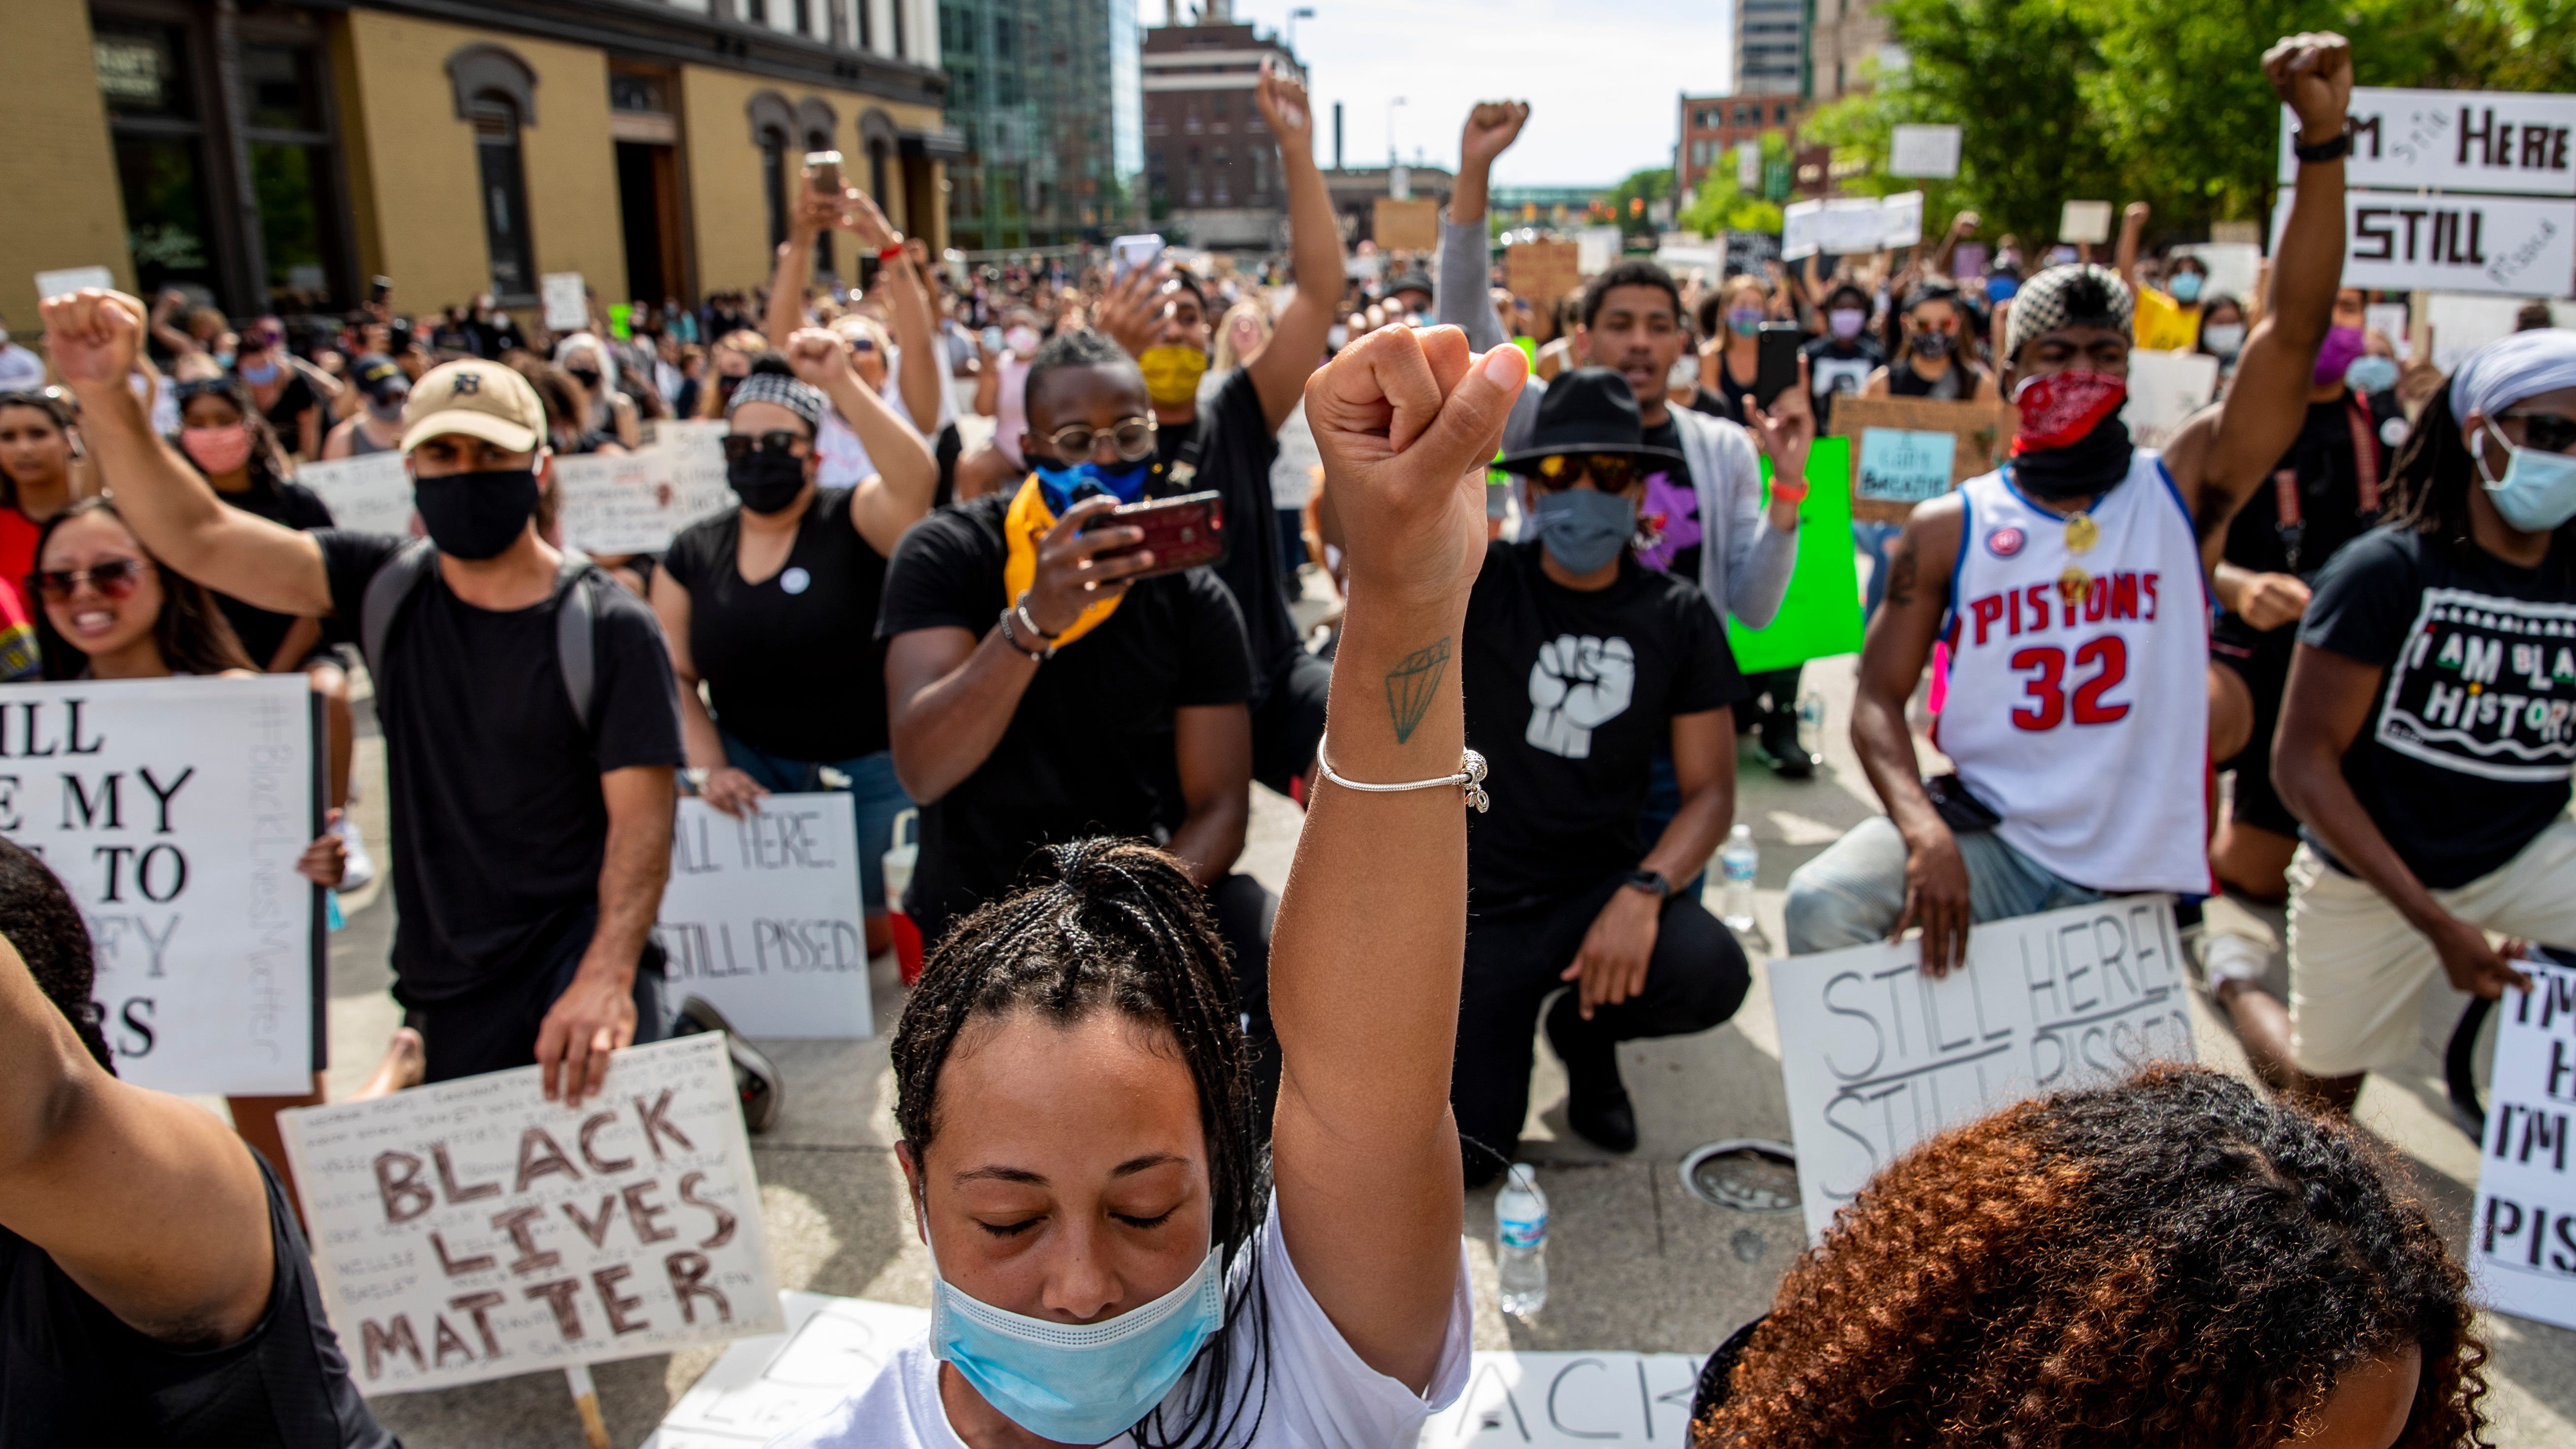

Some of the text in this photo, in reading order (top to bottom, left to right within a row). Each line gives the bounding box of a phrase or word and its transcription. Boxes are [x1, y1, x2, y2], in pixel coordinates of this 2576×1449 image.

[2353, 207, 2486, 266] STILL
[1971, 571, 2161, 646] PISTONS
[2011, 635, 2132, 731] 32
[2434, 633, 2503, 685] AM
[2512, 643, 2576, 690] BLA
[57, 765, 197, 834] MY
[92, 841, 189, 905] TO
[1822, 959, 2014, 1082] STILL
[373, 1087, 696, 1224] BLACK
[2493, 1102, 2567, 1172] I'M
[429, 1171, 737, 1277] LIVES
[359, 1249, 733, 1380] MATTER
